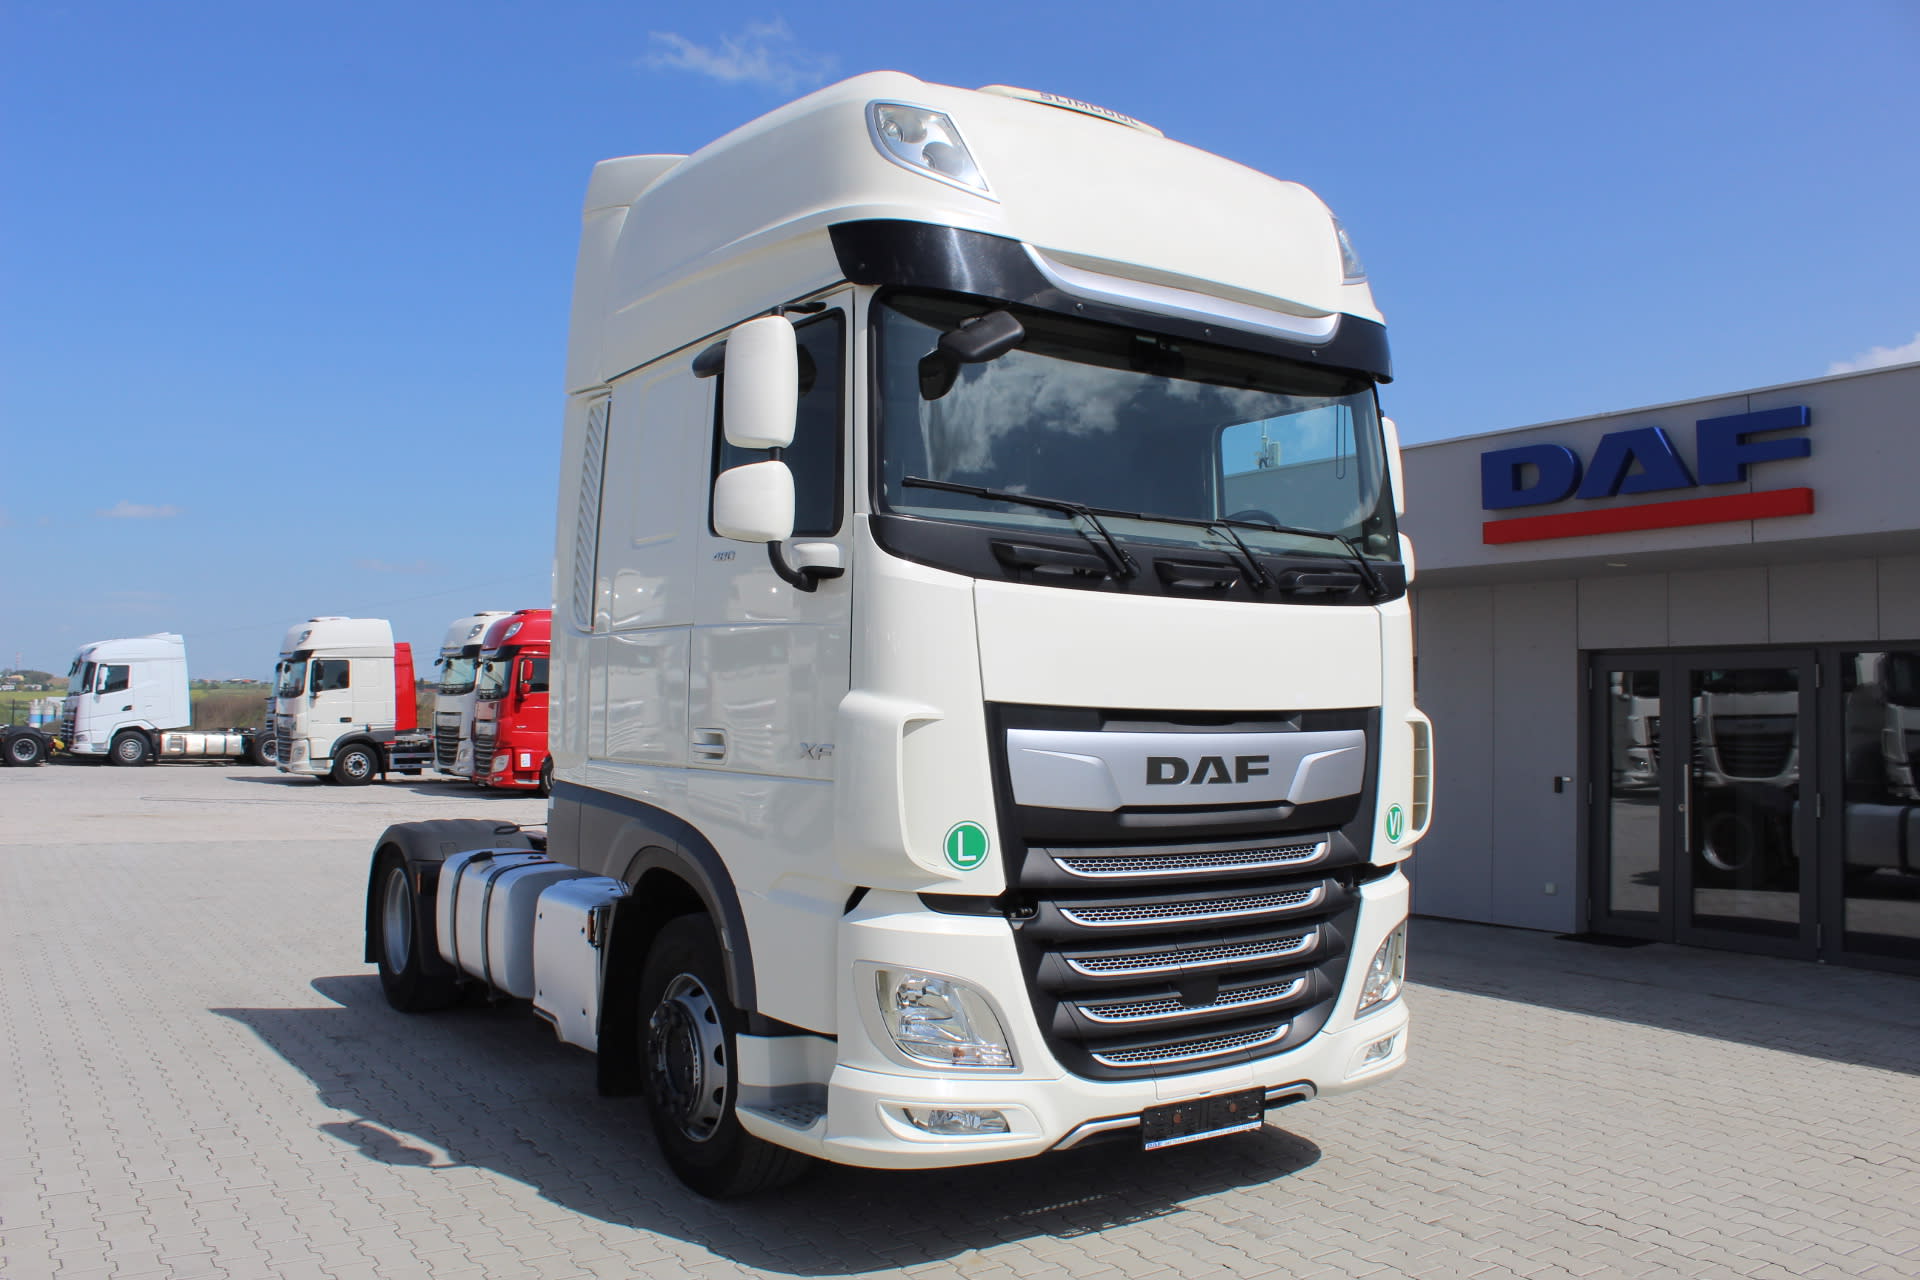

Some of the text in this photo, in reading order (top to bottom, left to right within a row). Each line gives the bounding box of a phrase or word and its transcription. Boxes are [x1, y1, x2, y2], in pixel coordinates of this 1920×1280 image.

[1481, 405, 1812, 511] DAF
[800, 742, 835, 760] XF
[1146, 755, 1270, 785] DAF
[957, 831, 977, 862] L
